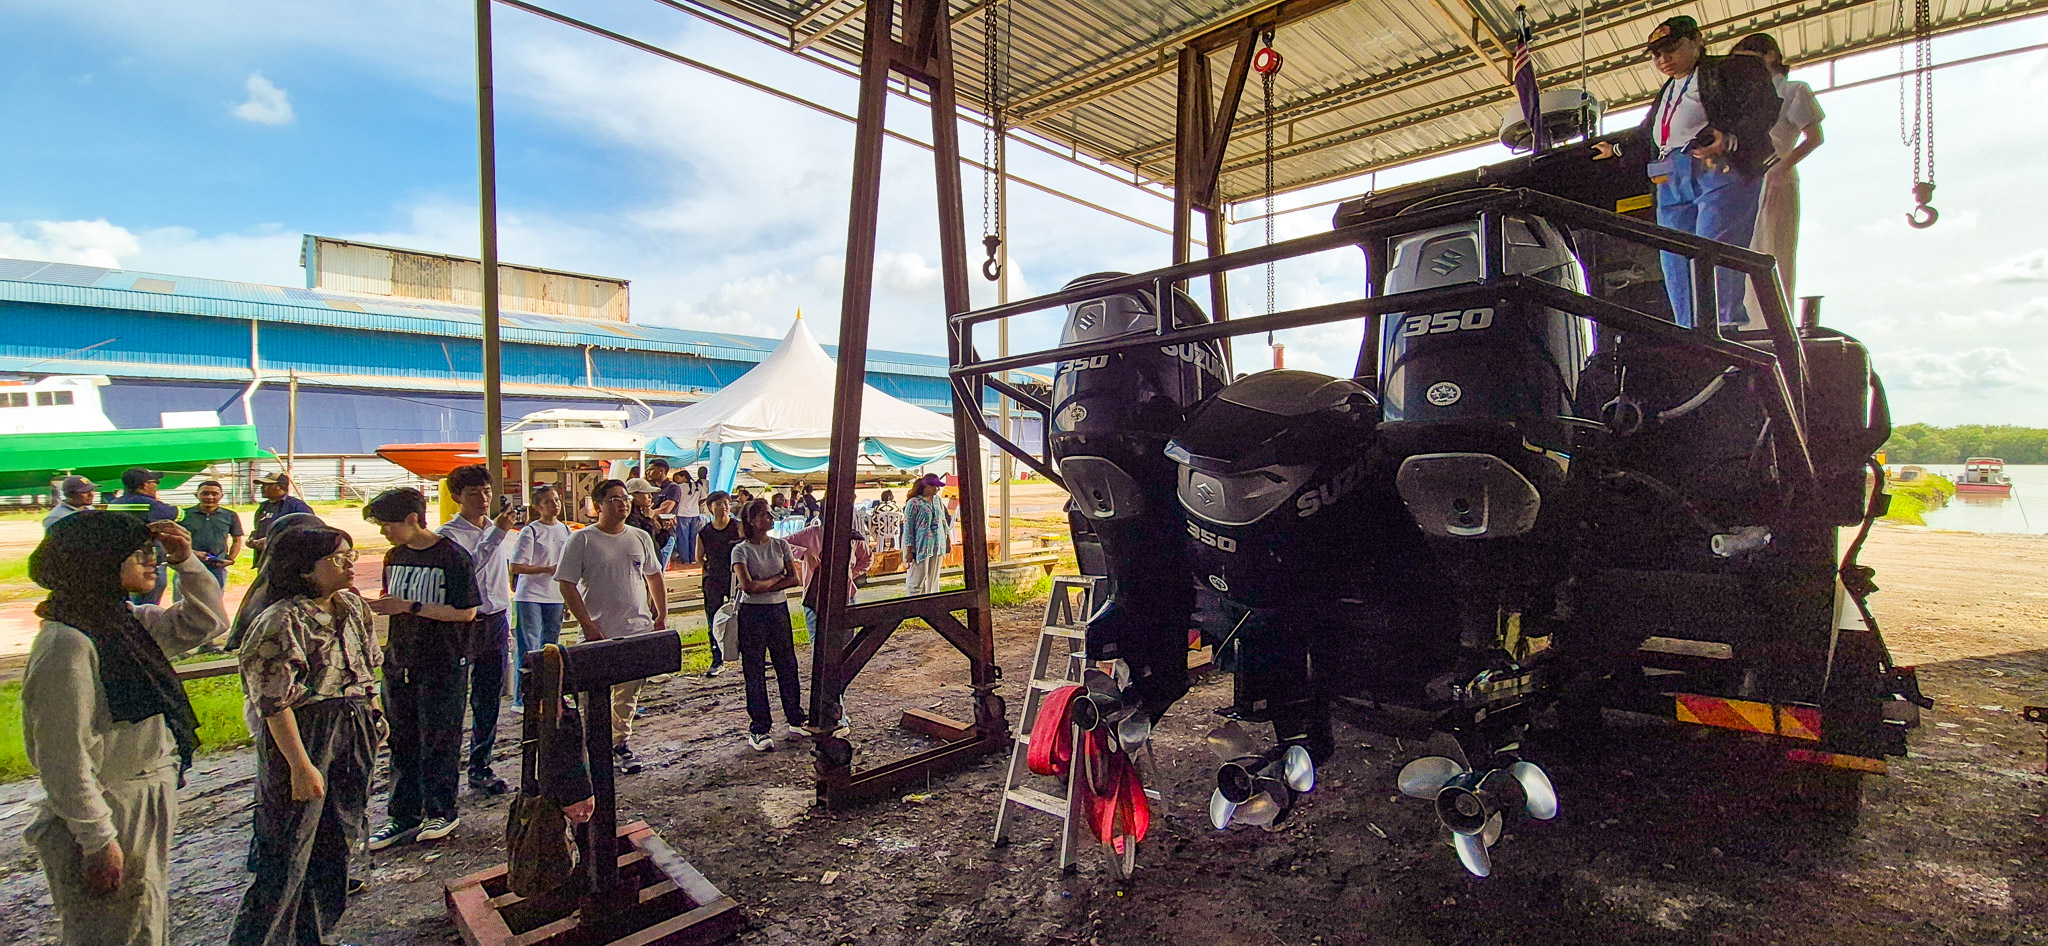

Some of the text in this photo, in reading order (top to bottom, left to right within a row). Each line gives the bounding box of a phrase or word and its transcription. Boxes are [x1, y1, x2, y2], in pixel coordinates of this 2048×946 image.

[1402, 307, 1494, 338] 350
[1060, 354, 1109, 374] 350
[1186, 519, 1237, 553] 350
